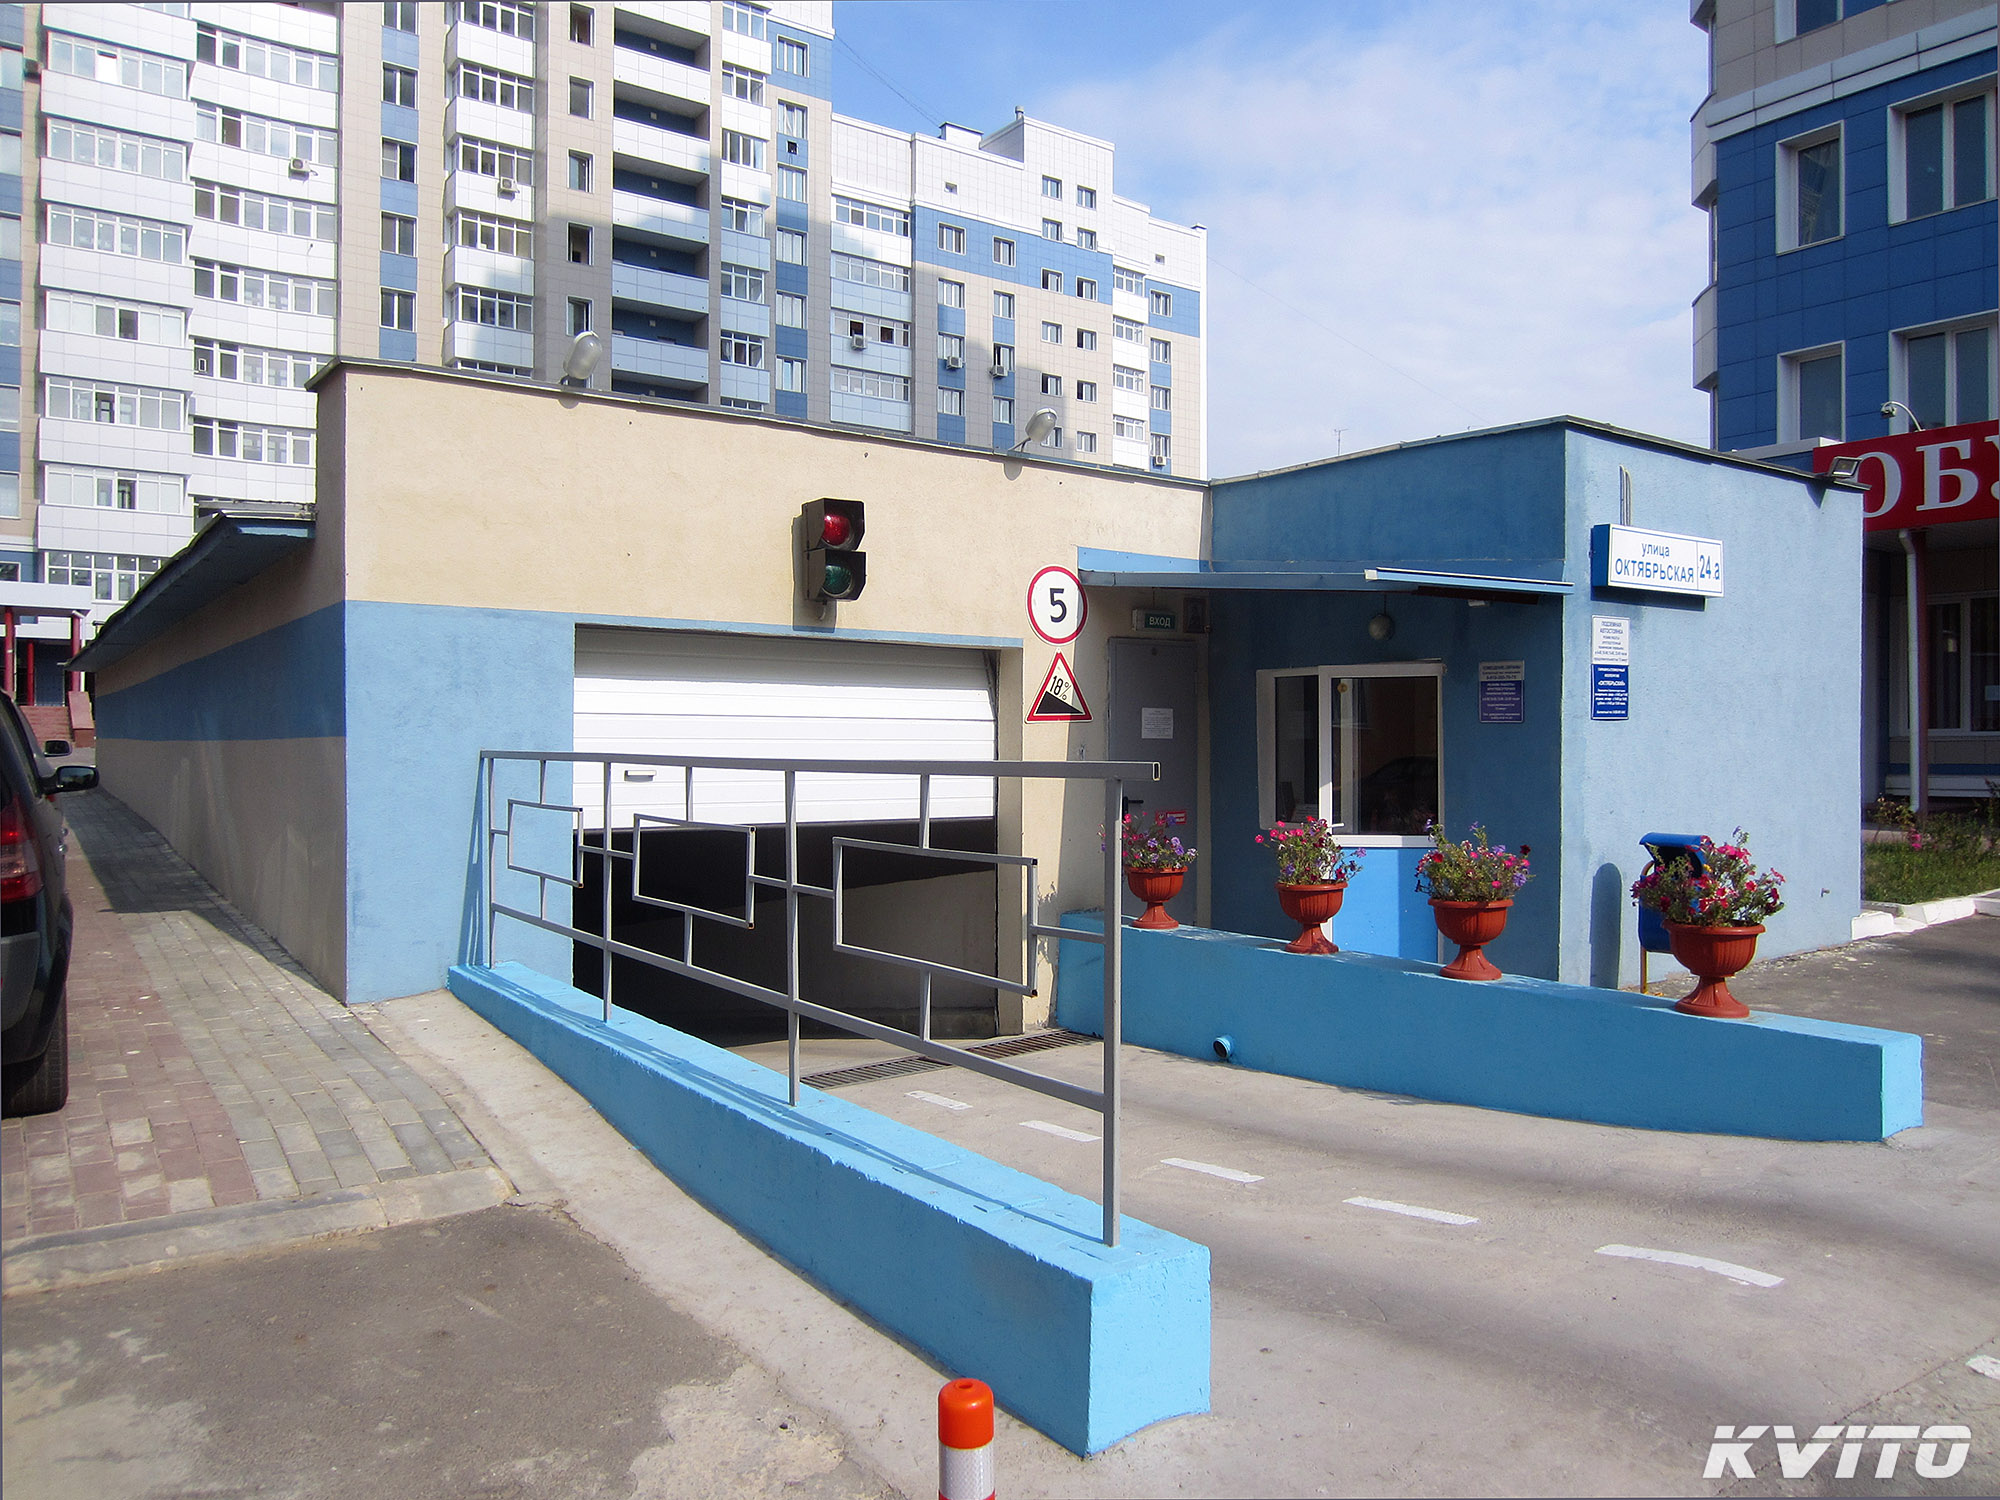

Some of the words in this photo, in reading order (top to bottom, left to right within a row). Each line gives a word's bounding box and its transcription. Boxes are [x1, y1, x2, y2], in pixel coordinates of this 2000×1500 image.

[1853, 434, 1999, 518] ОБ
[1641, 543, 1670, 558] улица
[1615, 558, 1694, 583] ОКТЯБРЬСКАЯ
[1049, 587, 1067, 623] 5
[1149, 616, 1171, 629] ВХОД
[1050, 675, 1071, 700] 18%
